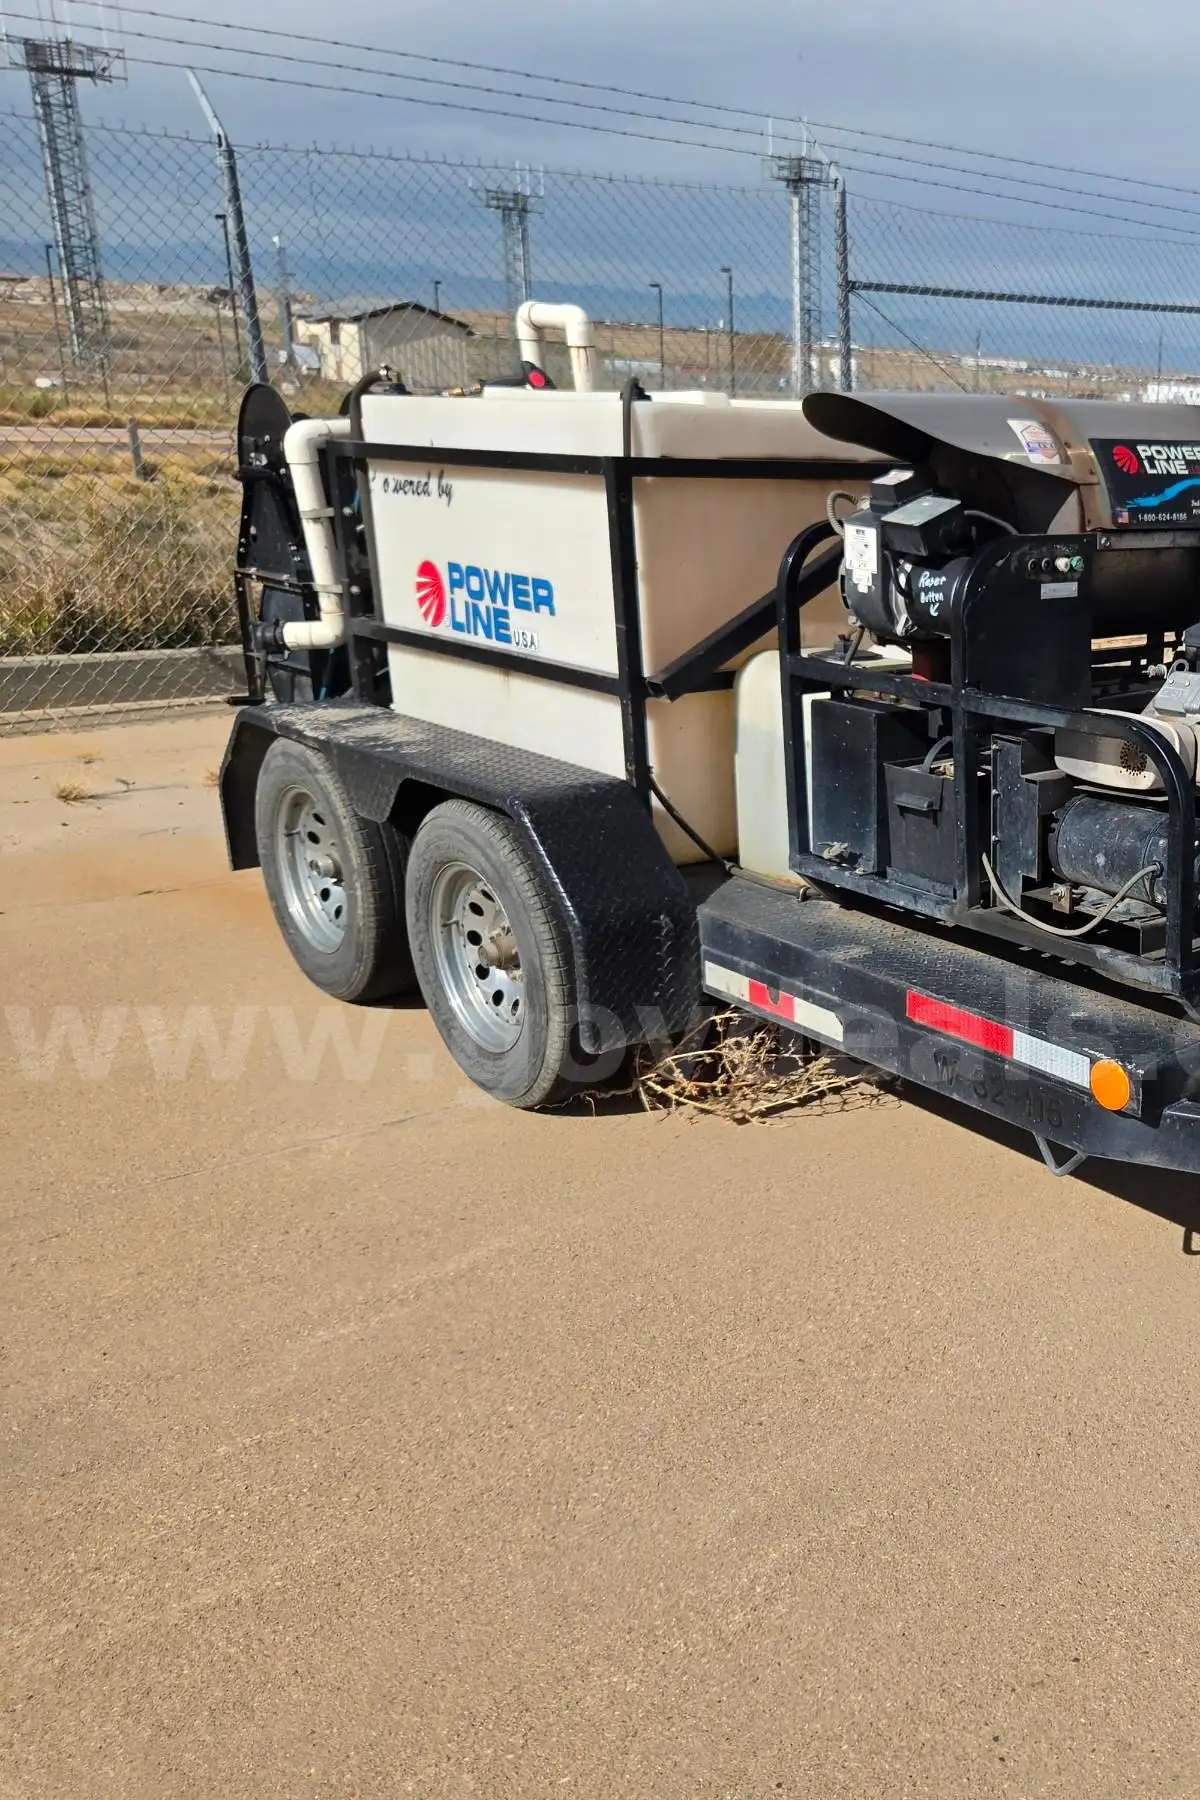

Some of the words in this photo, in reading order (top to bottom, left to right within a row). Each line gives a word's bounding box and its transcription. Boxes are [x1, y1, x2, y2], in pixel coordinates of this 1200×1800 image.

[370, 469, 432, 497] owered
[438, 469, 453, 508] by
[1142, 460, 1189, 475] LINE
[447, 561, 556, 616] POWER
[450, 597, 513, 645] LINE
